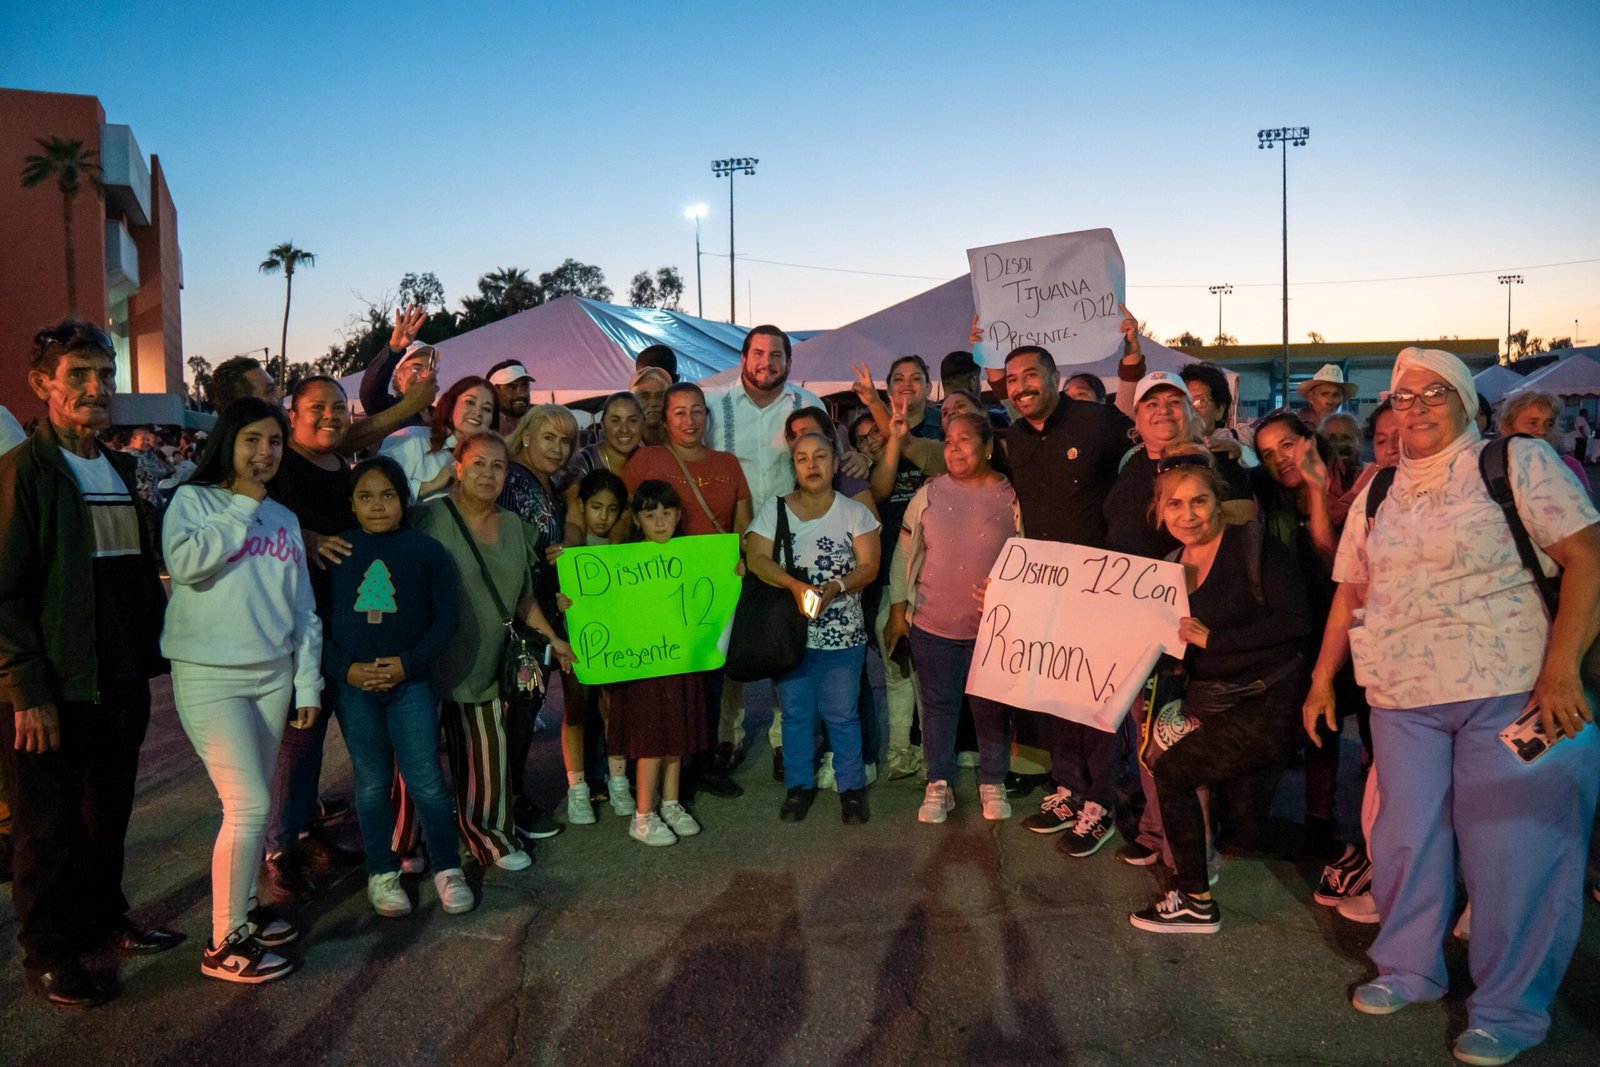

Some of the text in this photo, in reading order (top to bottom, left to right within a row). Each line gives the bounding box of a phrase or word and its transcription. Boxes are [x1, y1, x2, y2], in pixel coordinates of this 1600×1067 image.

[984, 252, 1033, 282] DESDE
[1002, 278, 1091, 318] TIJUANA
[574, 553, 683, 597] Distrito
[1081, 554, 1131, 595] 12
[1132, 563, 1178, 606] Con
[668, 576, 718, 626] 12
[579, 621, 681, 669] Presente
[982, 603, 1085, 682] Ramon
[1053, 804, 1073, 820] N
